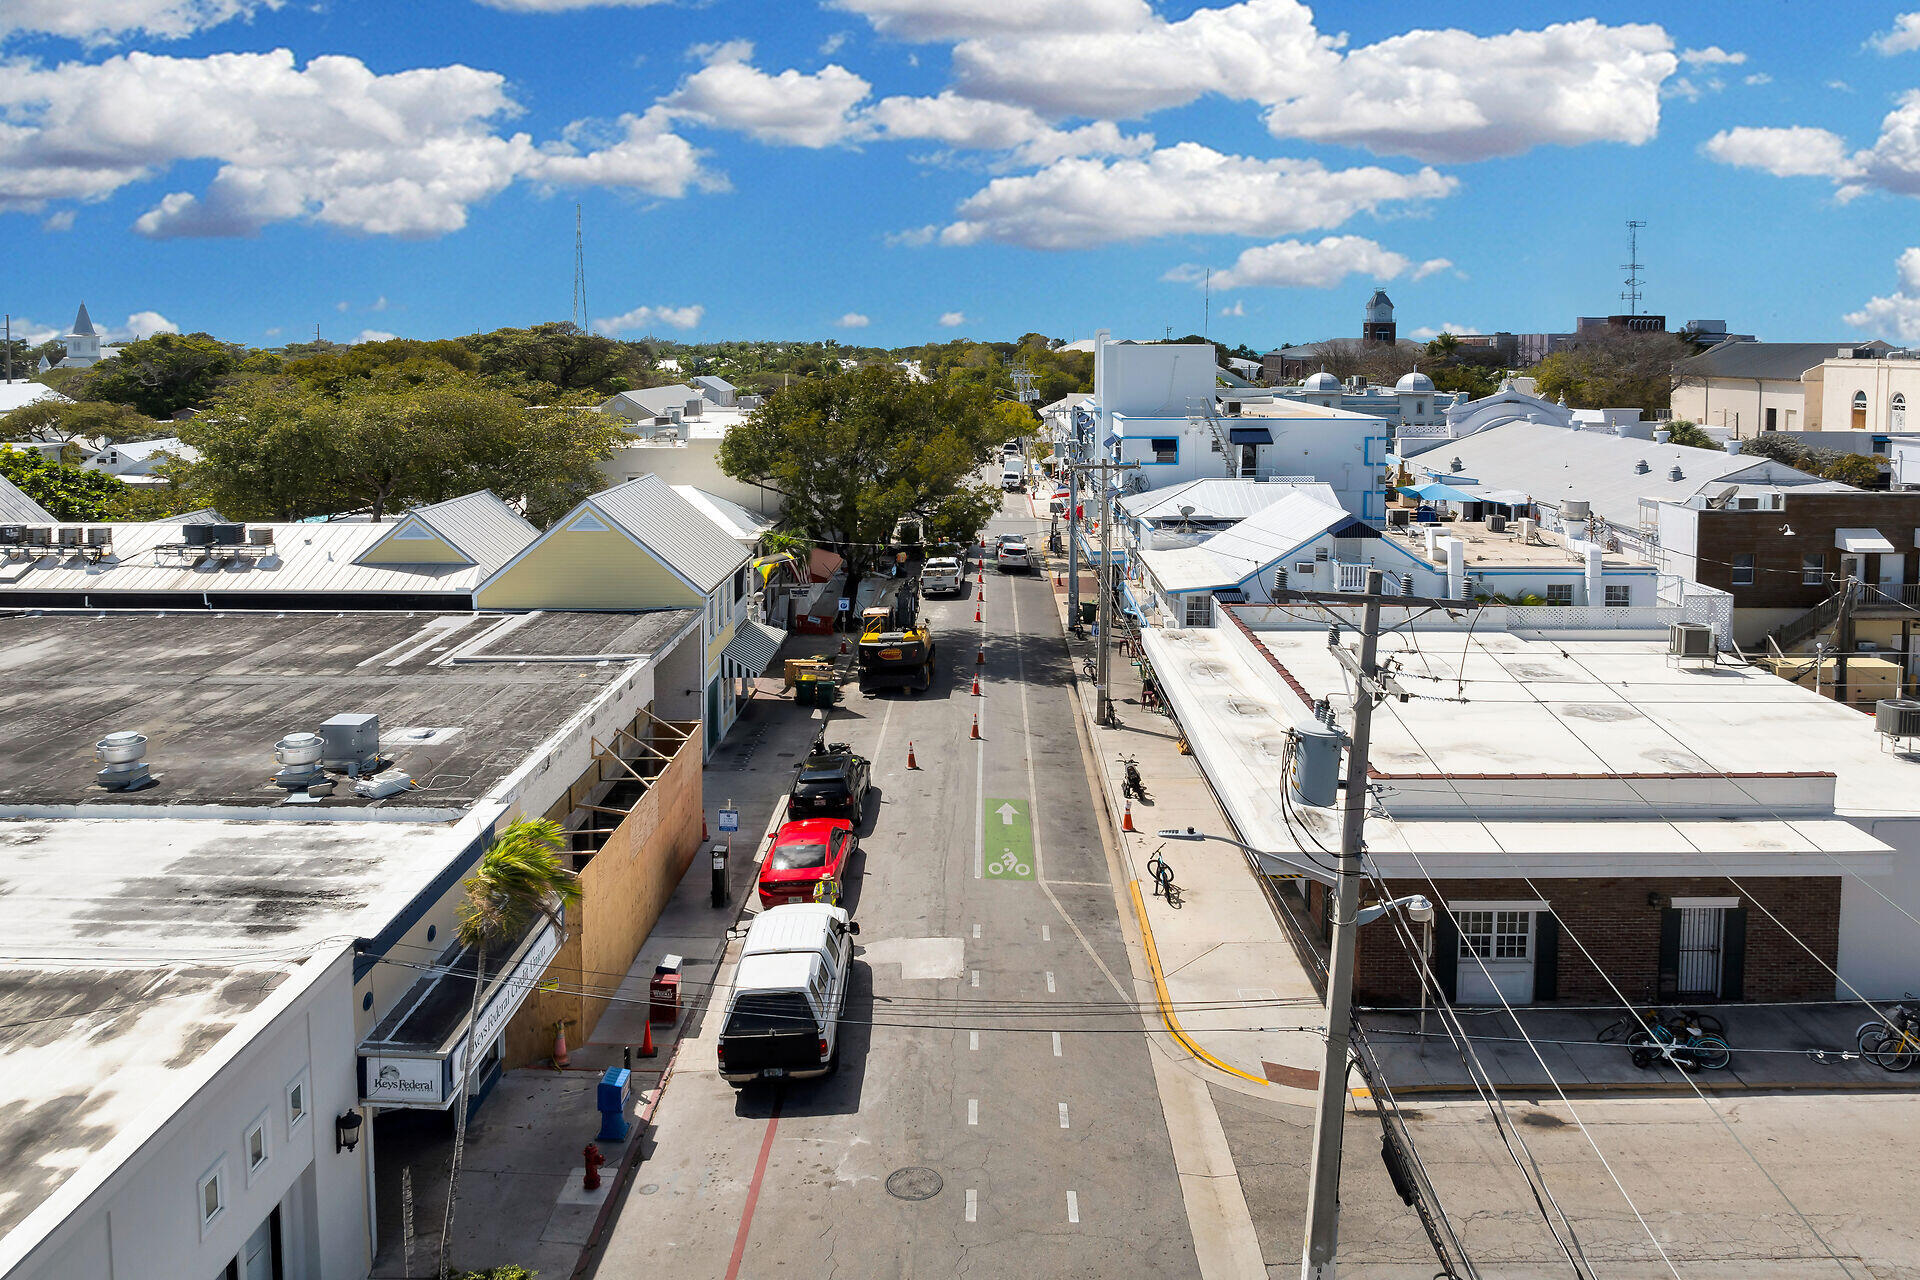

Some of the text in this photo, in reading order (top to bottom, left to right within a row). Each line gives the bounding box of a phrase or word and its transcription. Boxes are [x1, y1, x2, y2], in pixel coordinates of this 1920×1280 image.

[487, 990, 510, 1032] Federal
[510, 966, 529, 998] Credit
[530, 945, 546, 973] Union
[374, 1079, 398, 1090] Keys
[399, 1080, 433, 1090] Federal
